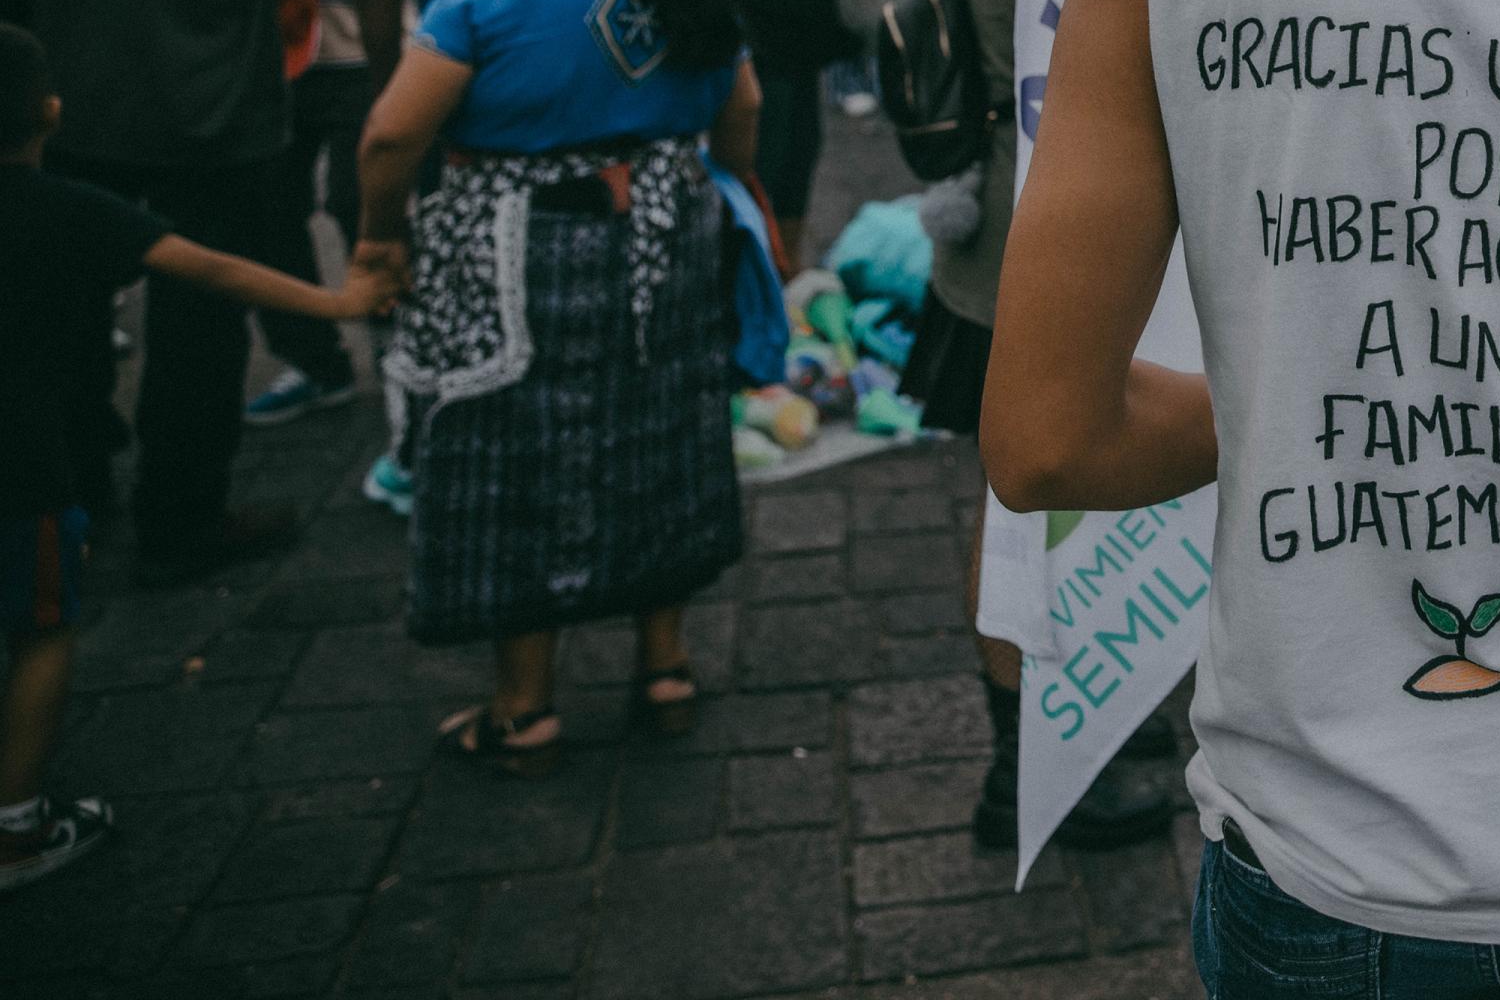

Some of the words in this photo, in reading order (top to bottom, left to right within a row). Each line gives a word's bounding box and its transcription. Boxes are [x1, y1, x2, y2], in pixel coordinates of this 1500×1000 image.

[1196, 15, 1454, 101] GRACIAS
[1256, 189, 1440, 281] HABER
[1355, 299, 1405, 377] A
